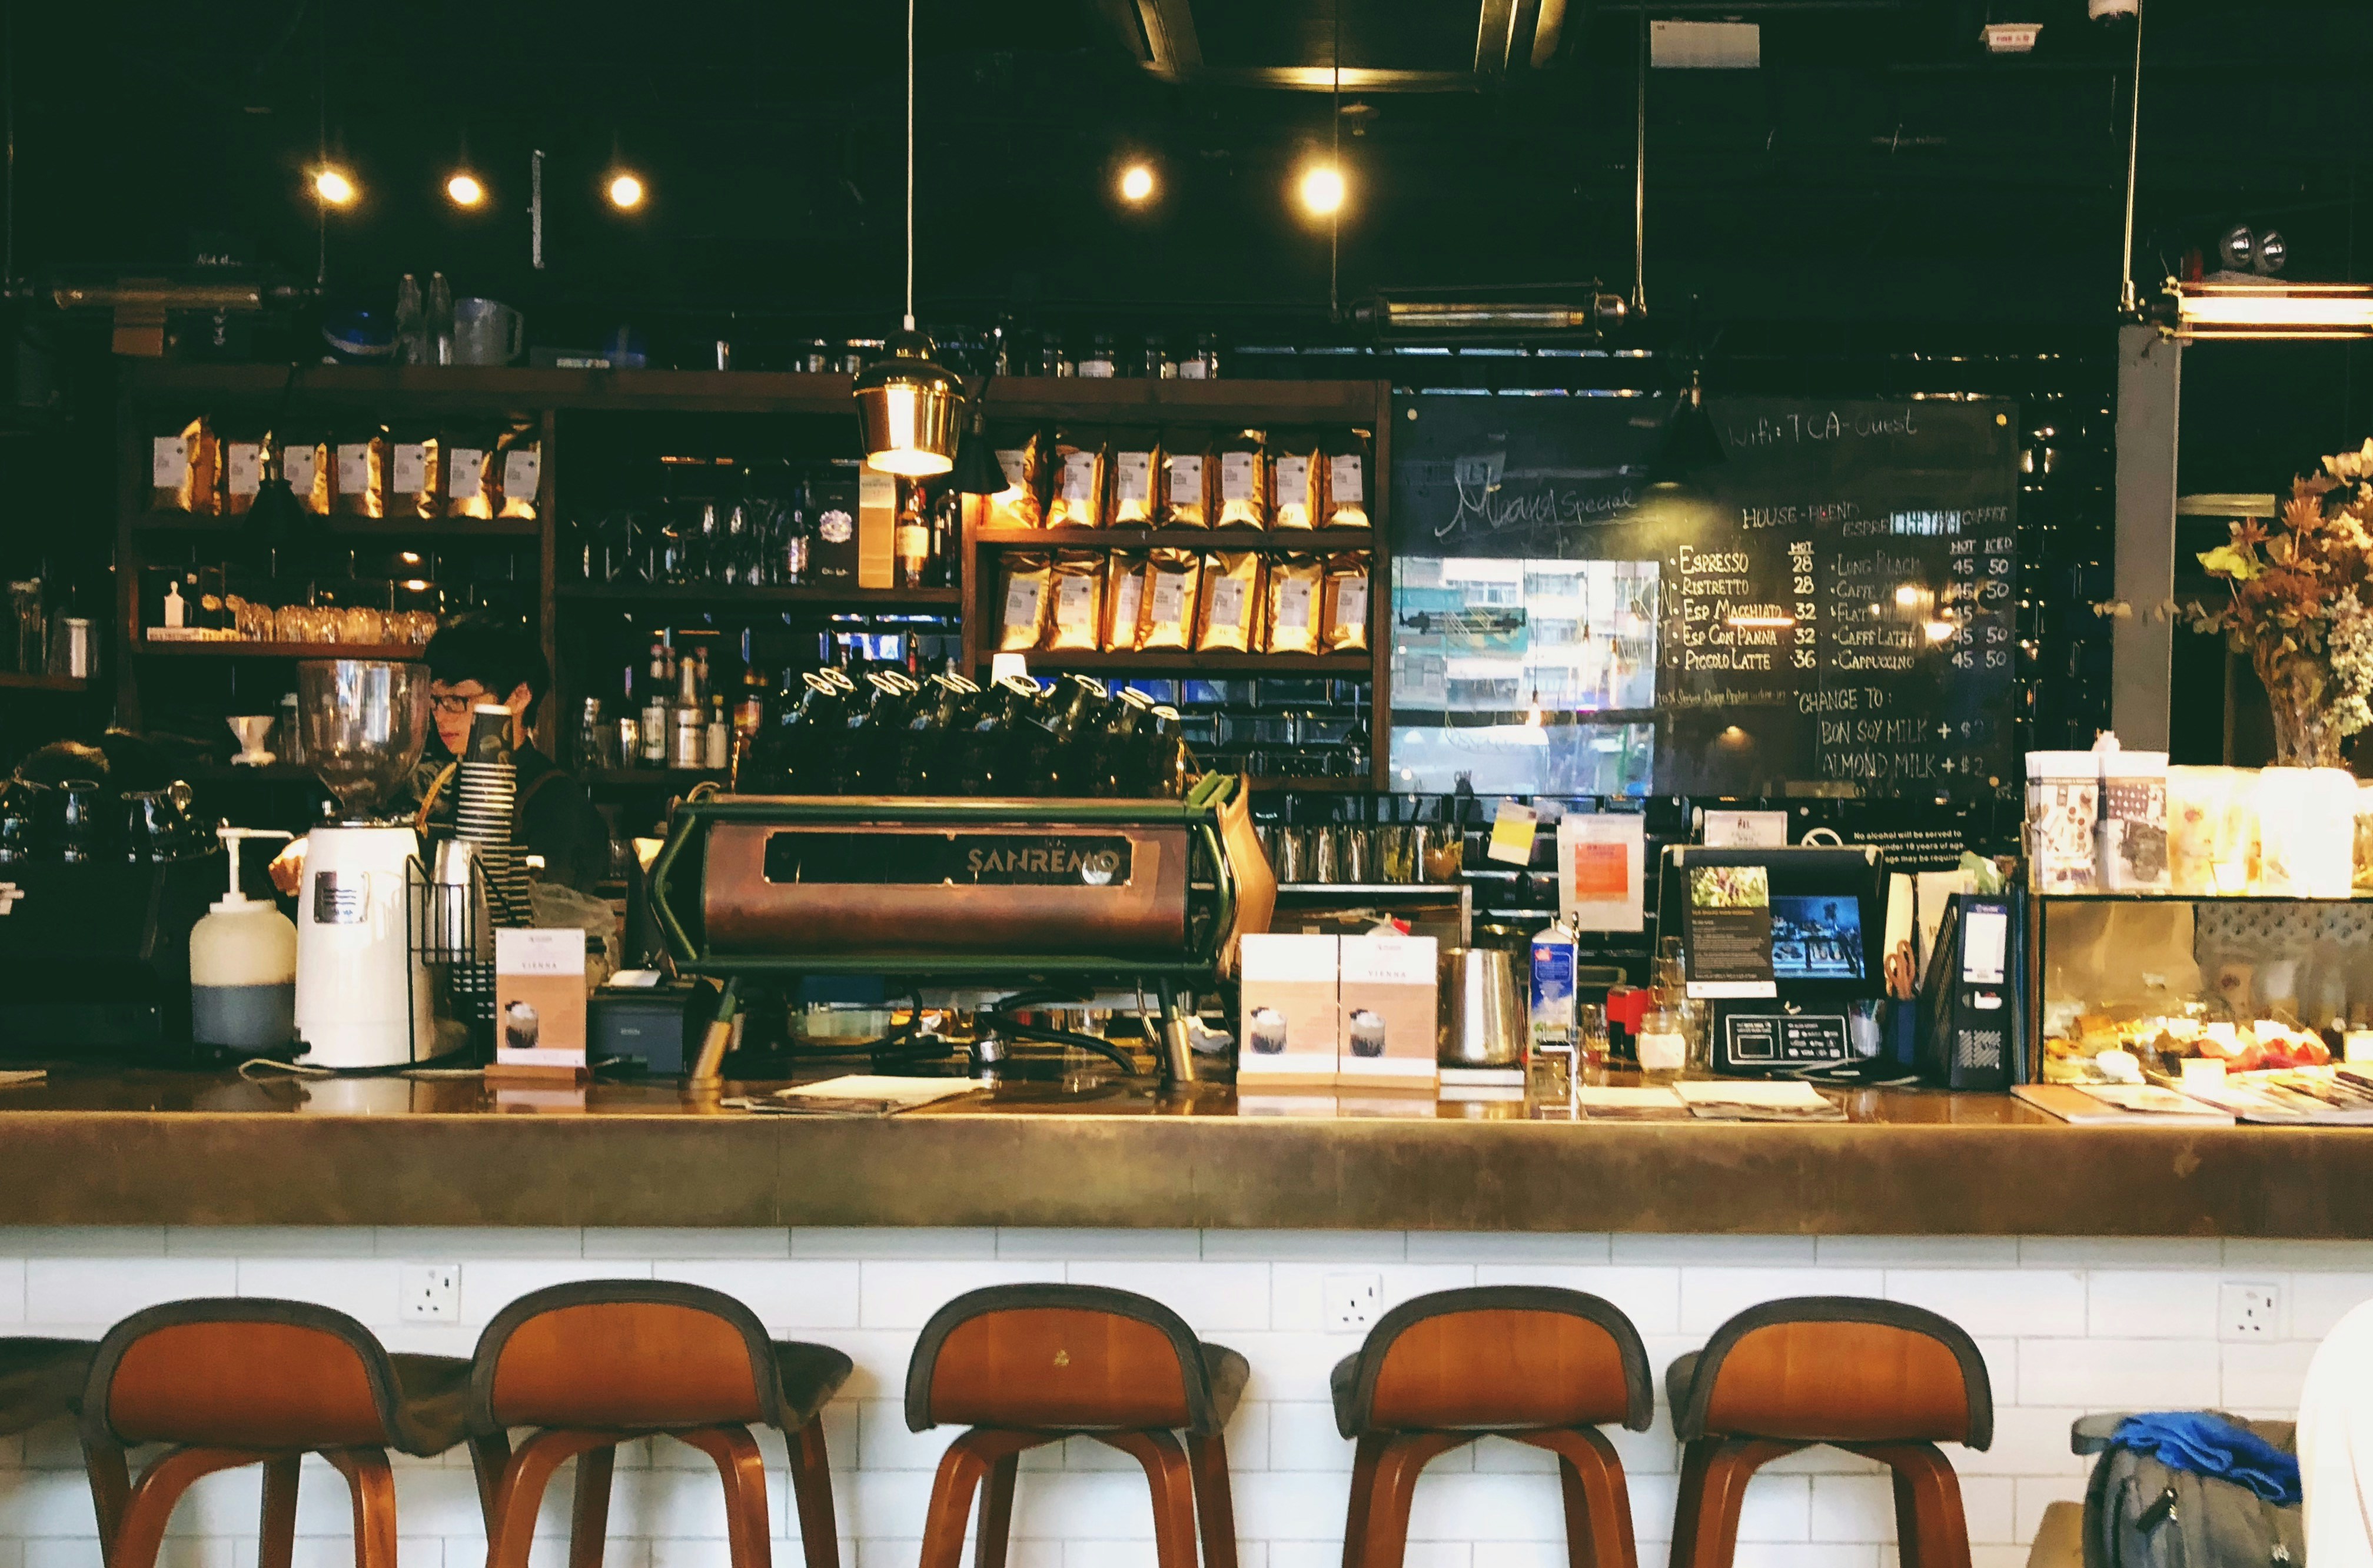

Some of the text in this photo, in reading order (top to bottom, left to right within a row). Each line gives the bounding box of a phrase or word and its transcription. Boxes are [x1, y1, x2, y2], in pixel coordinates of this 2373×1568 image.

[1561, 487, 1638, 524] Special
[1790, 540, 1813, 554] HOT
[1951, 536, 2012, 554] HOT ICED
[1679, 545, 1813, 574] ESPRESSO 28
[1953, 559, 1973, 574] 45
[1988, 559, 2009, 575] 50
[1680, 576, 1814, 596] RISTRETTO 28
[1953, 582, 1973, 597] 45
[1986, 580, 2009, 599] 50
[1683, 597, 1817, 622] ESP MACCHIATO 32
[1837, 602, 1866, 623] FLAT
[1953, 606, 1973, 620] 45
[1683, 621, 1816, 646] ESP CON PANNA 32
[1952, 627, 1973, 645] 45
[1986, 626, 2008, 645] 50
[1684, 647, 1817, 670] PICCOLO LATTE 36
[1838, 649, 2007, 670] CAPPUCCINO 45 50
[1857, 718, 1883, 743] SOY
[1887, 717, 1928, 744] MILK
[1823, 751, 1888, 779] ALMOND
[1895, 752, 1936, 779] MILK
[1854, 829, 1962, 841] No alcohol will be served to
[1916, 842, 1938, 852] years
[1940, 842, 1947, 850] of
[967, 848, 1121, 873] SANREMO
[1885, 855, 1900, 865] age
[1901, 855, 1918, 865] may
[1919, 854, 1929, 863] be
[1368, 969, 1407, 978] VIENNA
